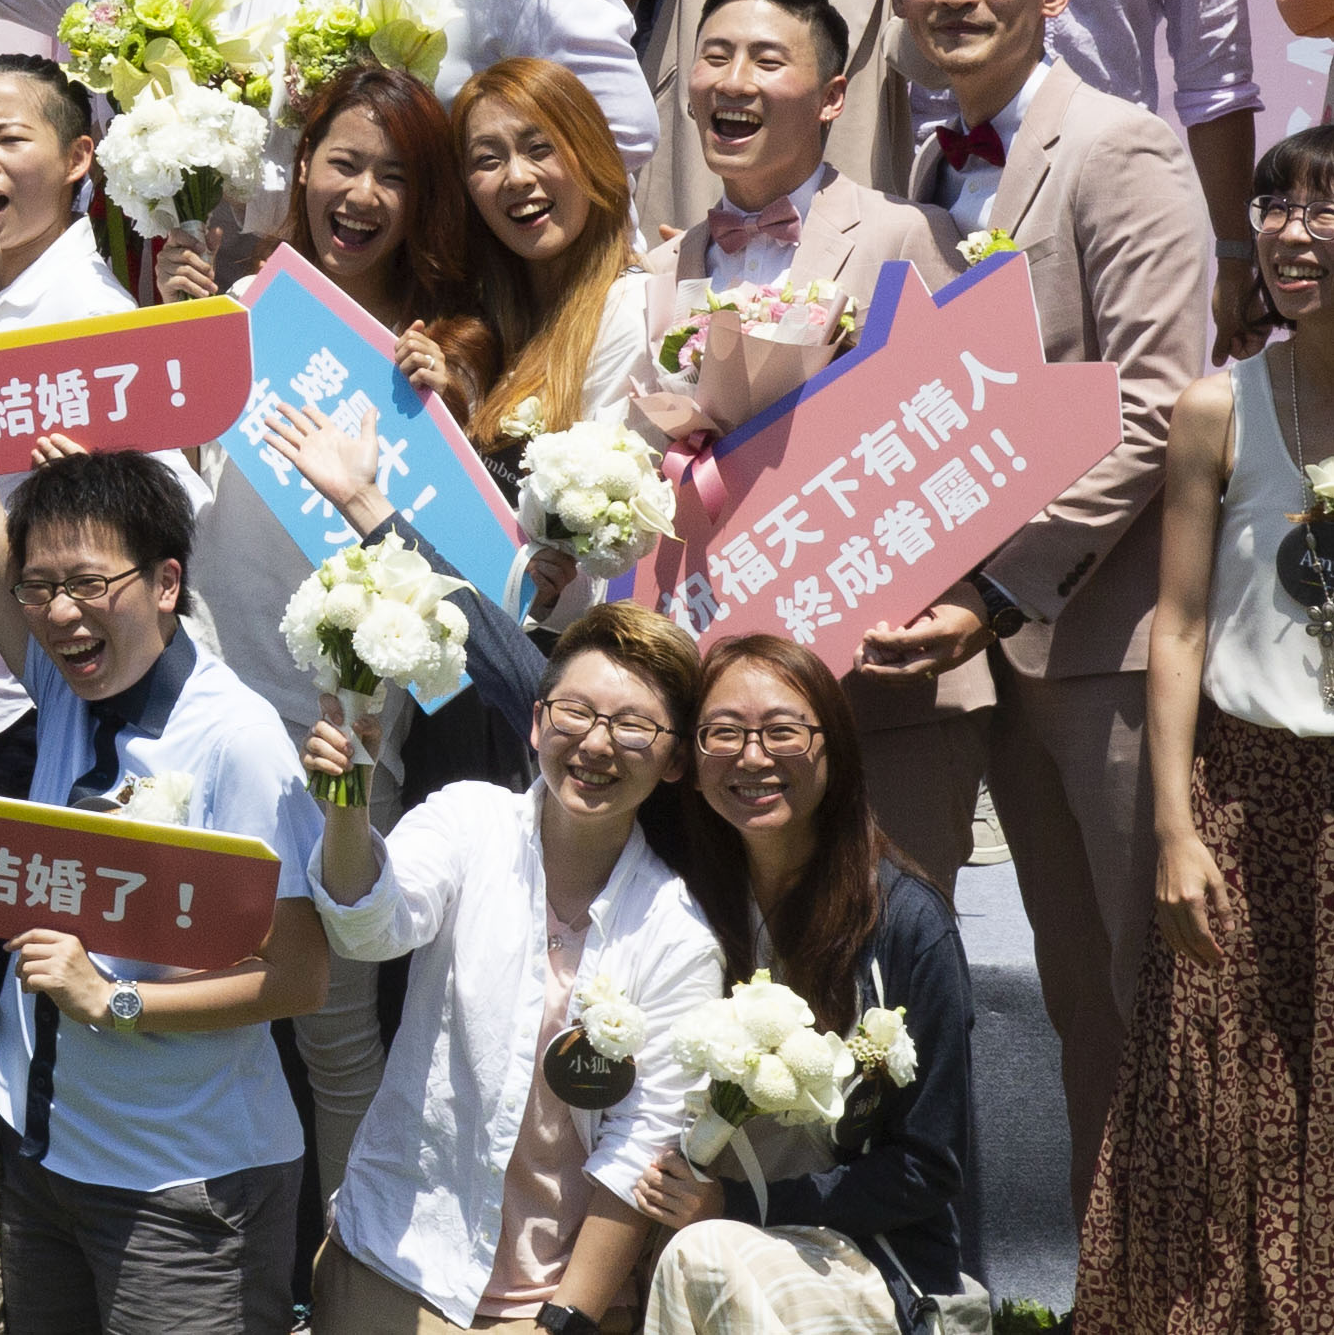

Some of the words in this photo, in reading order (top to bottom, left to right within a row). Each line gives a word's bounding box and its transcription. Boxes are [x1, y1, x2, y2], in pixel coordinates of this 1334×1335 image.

[479, 450, 519, 486] mbe
[662, 350, 1019, 641] 祝福天下有情人
